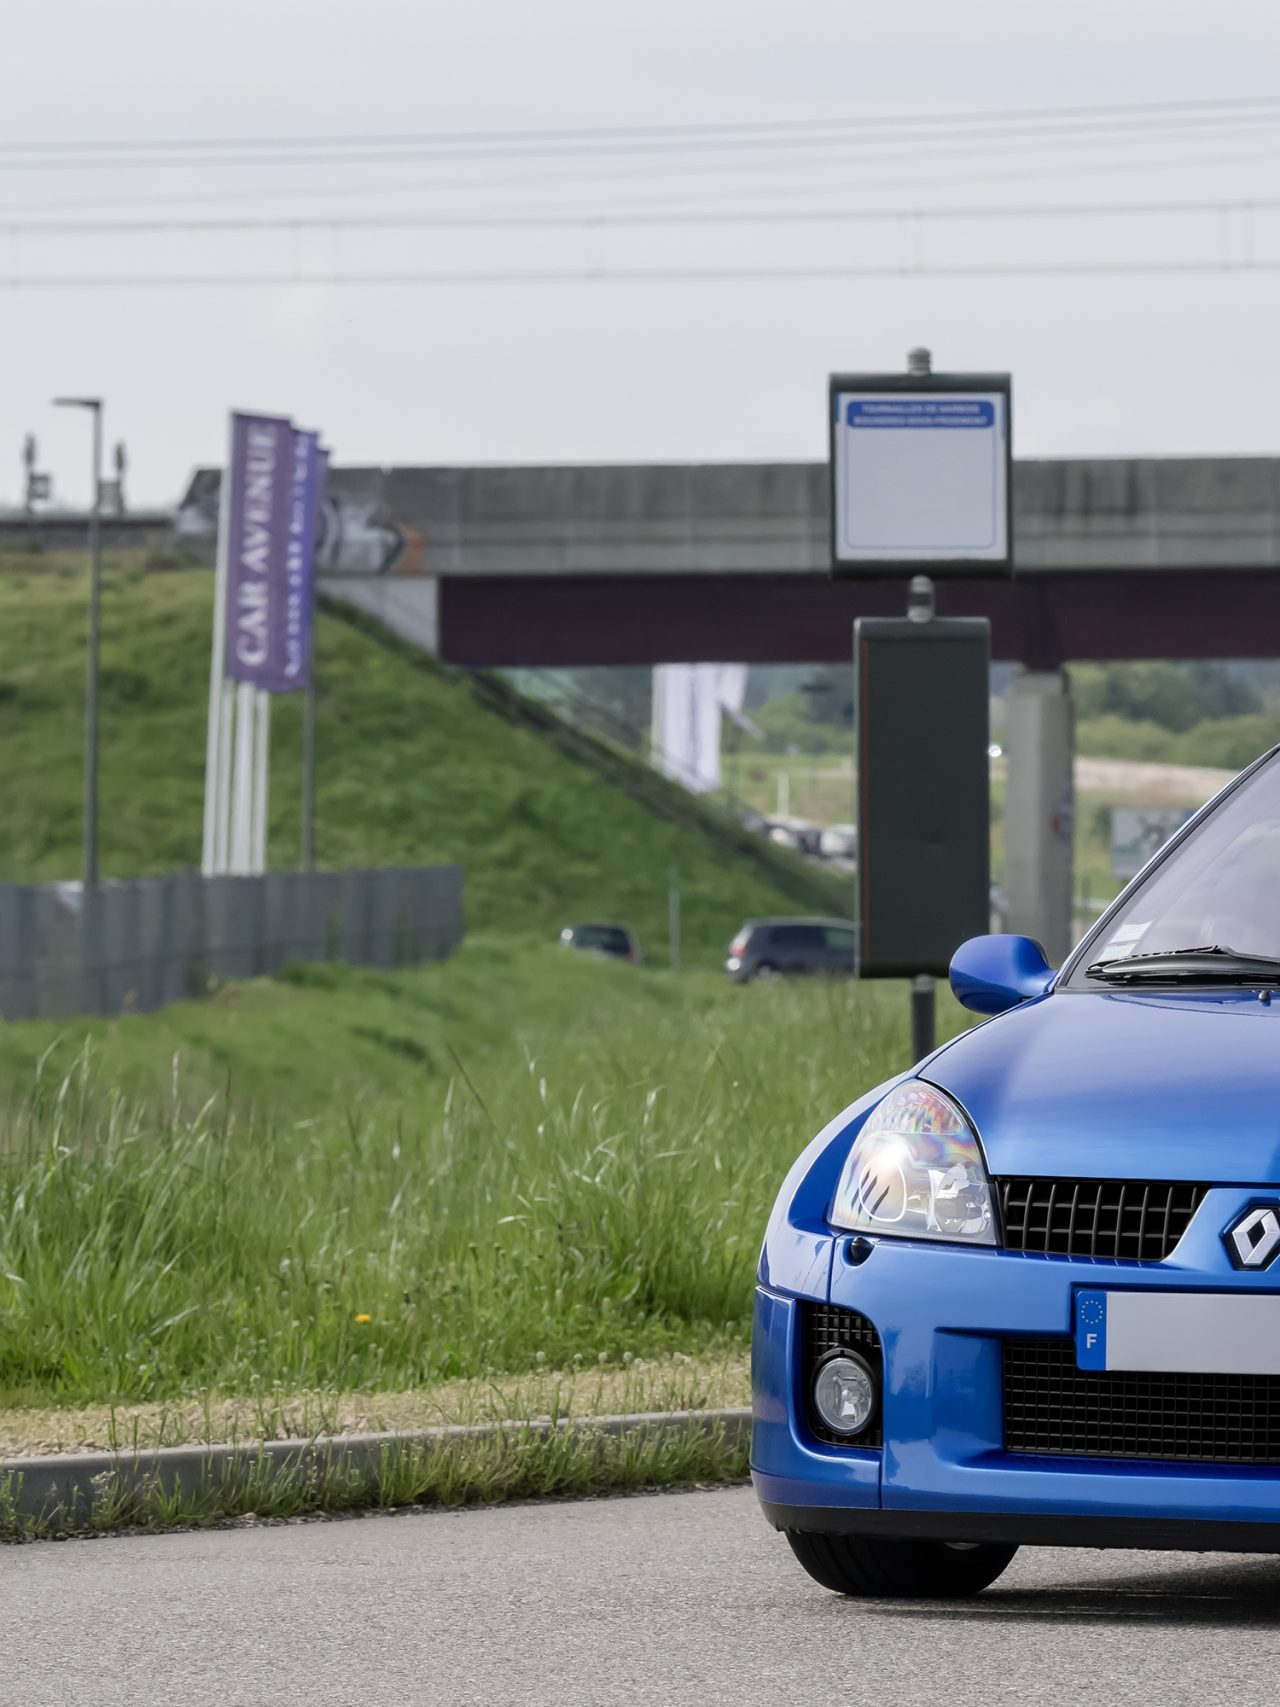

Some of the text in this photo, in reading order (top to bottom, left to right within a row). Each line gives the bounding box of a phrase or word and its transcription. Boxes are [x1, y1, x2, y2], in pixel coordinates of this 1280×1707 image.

[236, 424, 276, 667] CAR AVENUE
[1086, 1334, 1097, 1349] F
